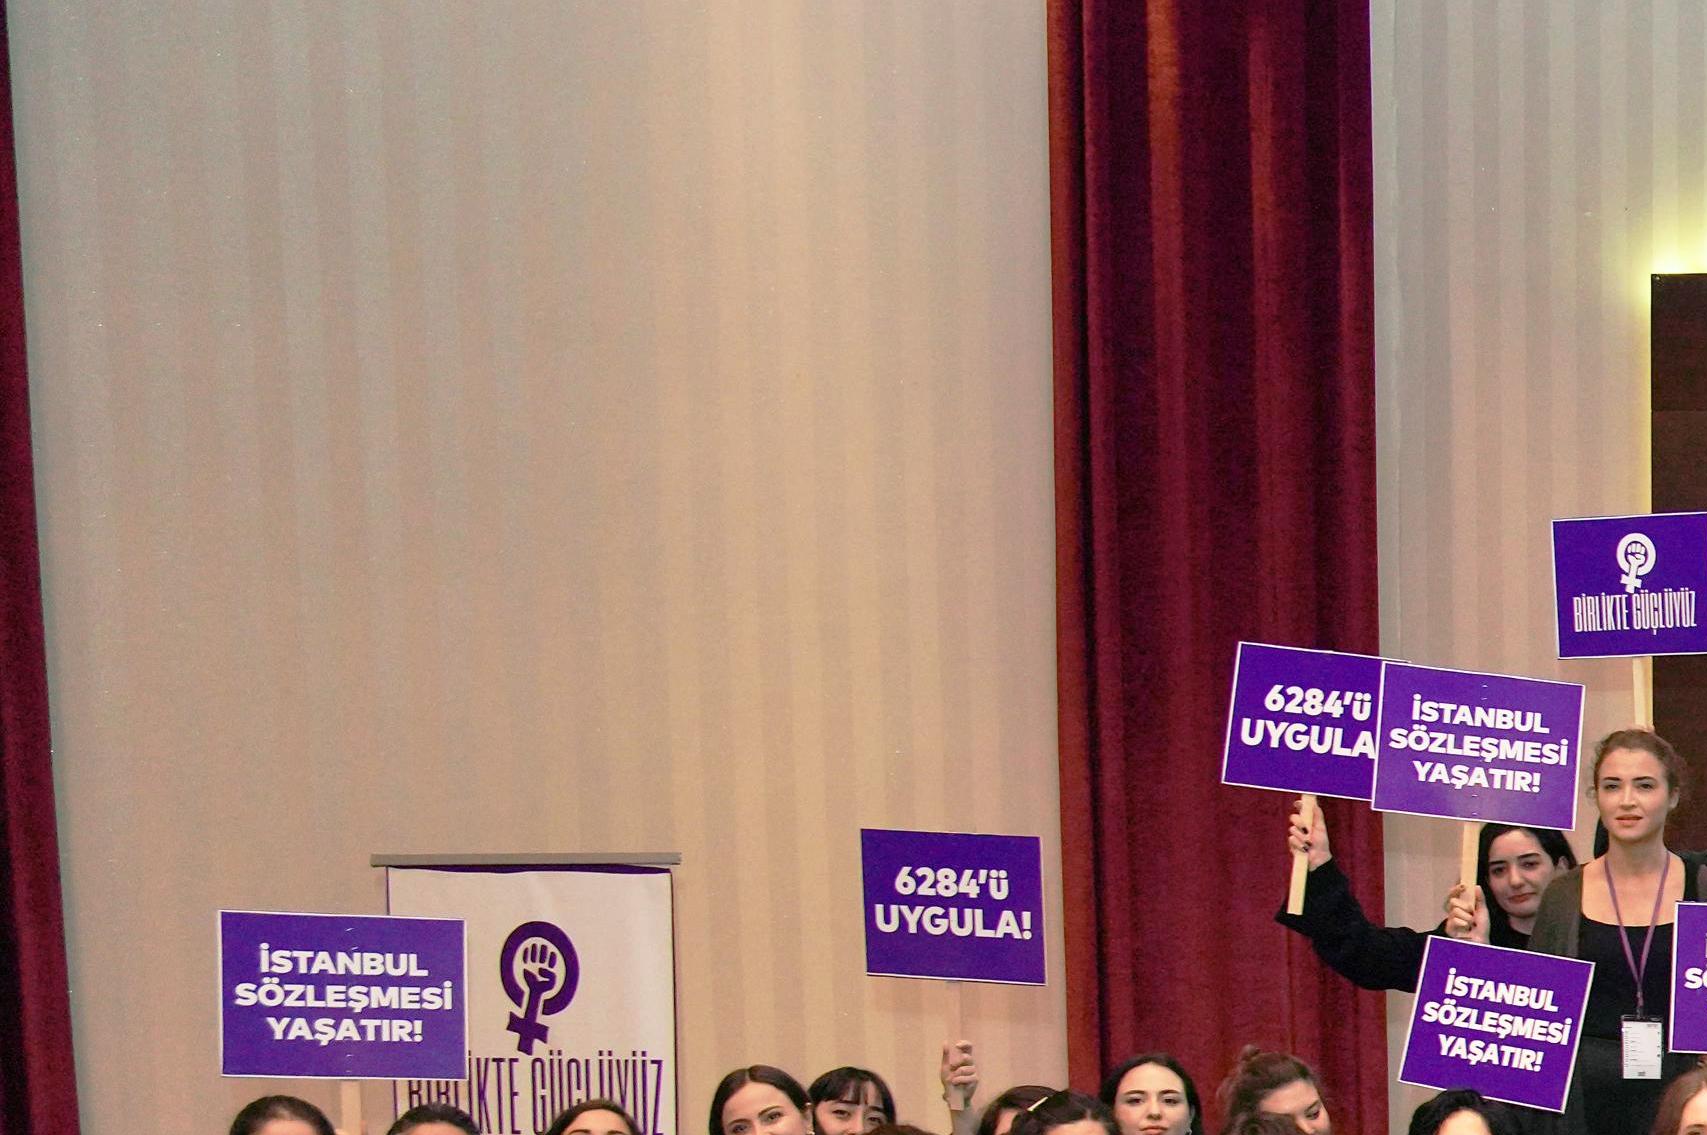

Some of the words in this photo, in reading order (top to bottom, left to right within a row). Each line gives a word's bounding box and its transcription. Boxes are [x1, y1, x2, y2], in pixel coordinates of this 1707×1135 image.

[1572, 591, 1630, 633] BİRLİKTE
[1631, 590, 1697, 636] GÜÇLÜYÜZ
[1264, 684, 1372, 721] 6284'Ü
[1411, 693, 1550, 734] İSTANBUL
[1239, 717, 1376, 760] UYGULA
[1388, 723, 1569, 766] SÖZLEŞMESİ
[1412, 760, 1541, 793] YAŞATIR!
[894, 866, 1009, 901] 6284'Ü
[874, 903, 1033, 940] UYGULA!
[259, 942, 429, 977] İSTANBUL
[234, 976, 453, 1013] SÖZLEŞMESİ
[1444, 967, 1559, 1013] İSTANBUL
[266, 1016, 423, 1046] YAŞATIR!
[1421, 997, 1573, 1046] SÖZLEŞMESİ
[1438, 1033, 1545, 1072] YAŞATIR!
